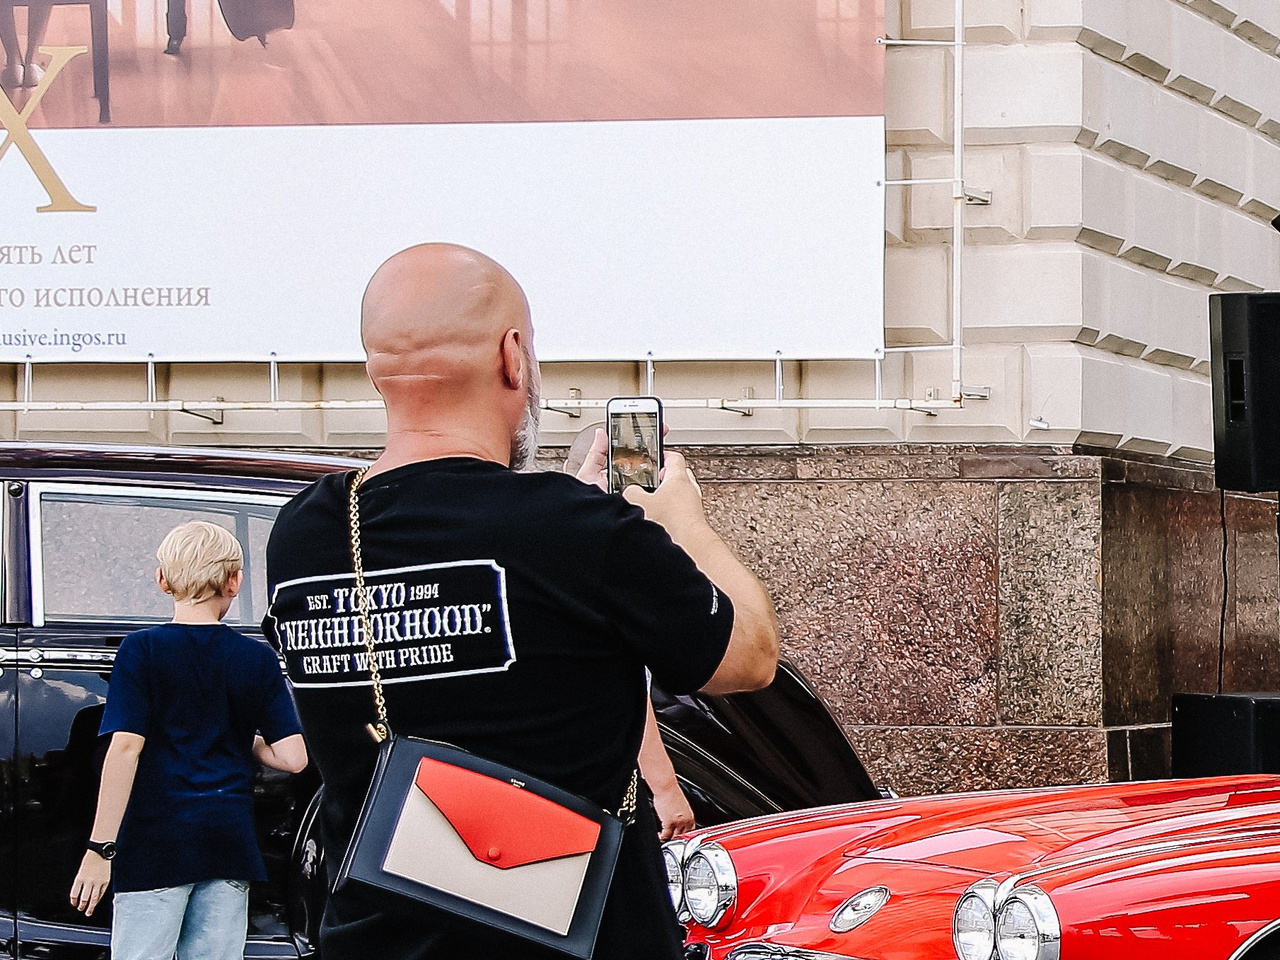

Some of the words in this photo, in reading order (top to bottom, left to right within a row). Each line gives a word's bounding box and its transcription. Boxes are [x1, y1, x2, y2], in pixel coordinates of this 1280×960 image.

[51, 244, 98, 264] лет
[34, 286, 212, 308] исполнения
[0, 328, 127, 352] usive.ingos.ru
[307, 594, 331, 611] EST.
[333, 582, 406, 613] TOKYO
[410, 583, 440, 601] 1994
[354, 650, 397, 672] WTH
[399, 643, 454, 667] PRIDE
